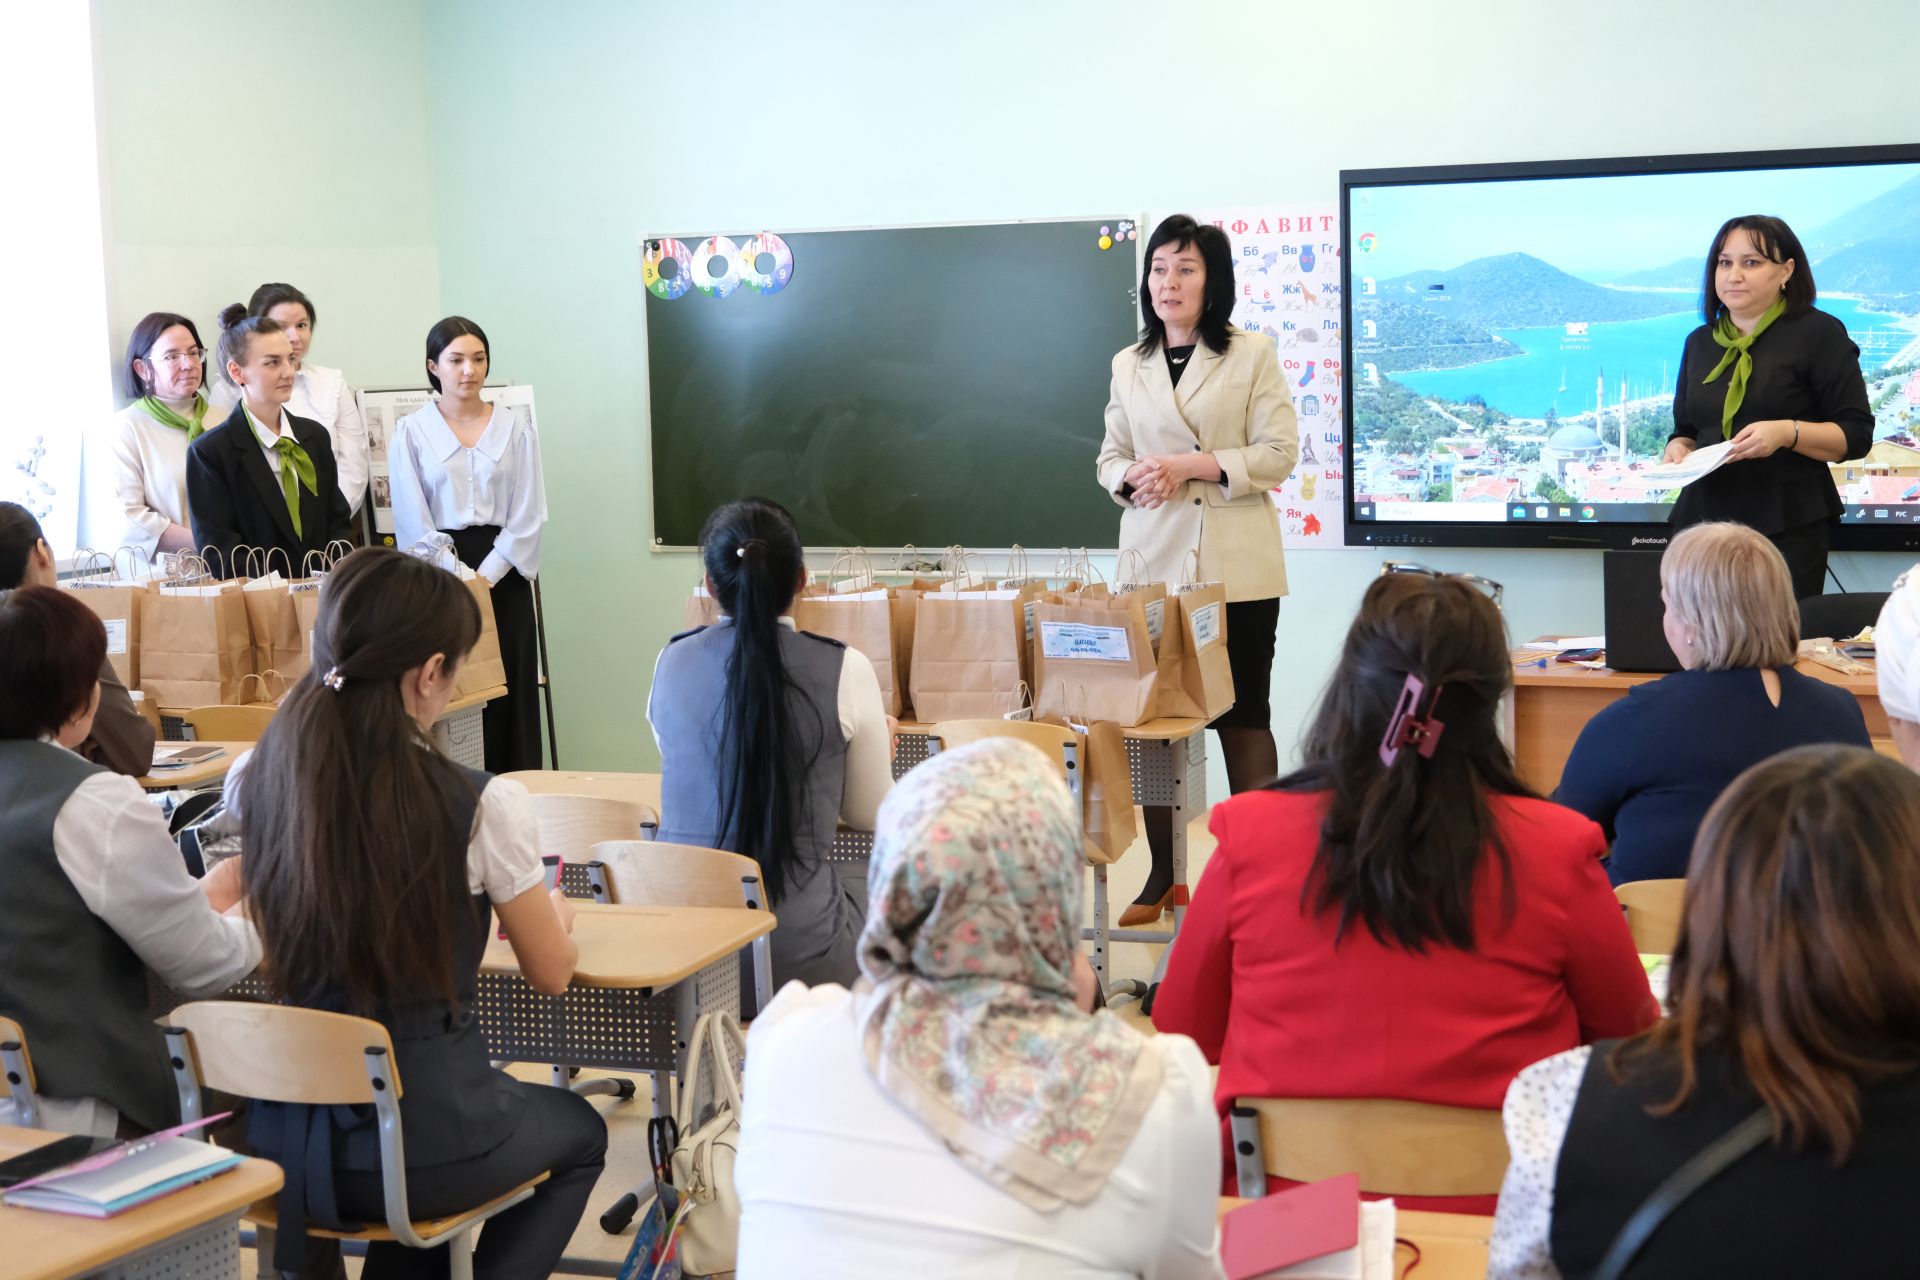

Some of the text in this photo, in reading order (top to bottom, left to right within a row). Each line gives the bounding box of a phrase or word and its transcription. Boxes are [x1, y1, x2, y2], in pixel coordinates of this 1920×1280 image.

[1211, 216, 1333, 234] ЛФАВИТ
[1243, 245, 1259, 256] Бб
[1282, 245, 1298, 255] Вв
[1322, 243, 1334, 254] Гг
[1282, 284, 1301, 294] Жж
[1283, 321, 1296, 331] Кк
[1322, 319, 1339, 330] Лл
[1283, 360, 1300, 369] Оо
[1324, 393, 1338, 406] Уу
[1324, 432, 1341, 444] Цц
[1286, 508, 1302, 518] Яя
[1631, 536, 1668, 546] geckotouch
